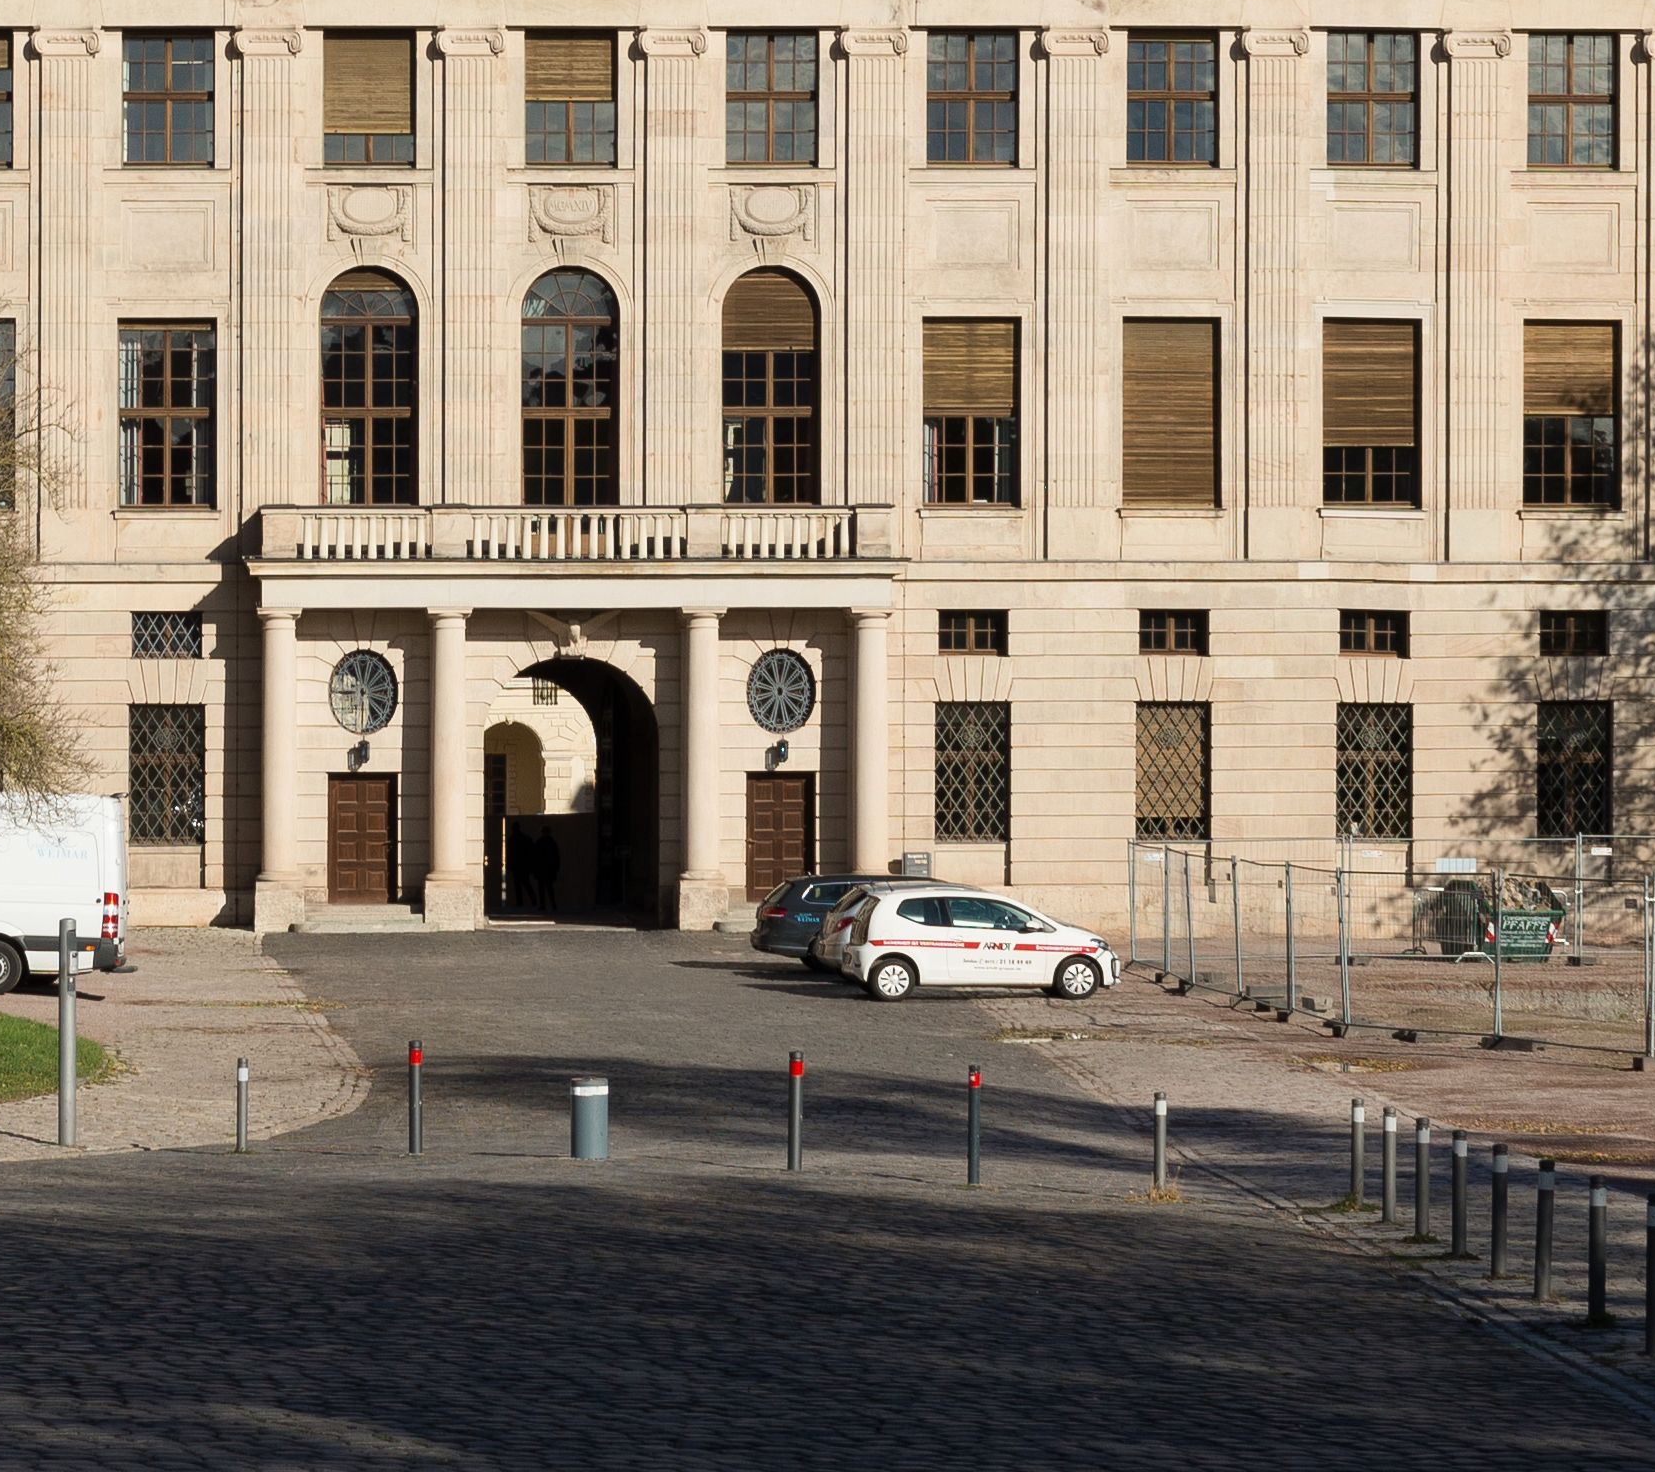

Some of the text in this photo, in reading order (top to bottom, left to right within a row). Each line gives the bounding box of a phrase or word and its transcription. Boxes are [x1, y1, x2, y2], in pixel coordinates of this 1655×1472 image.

[548, 199, 591, 212] MCMXIV
[36, 847, 89, 860] WEIMAR
[1502, 920, 1549, 931] PFAFFE
[983, 942, 1011, 951] ARNDT
